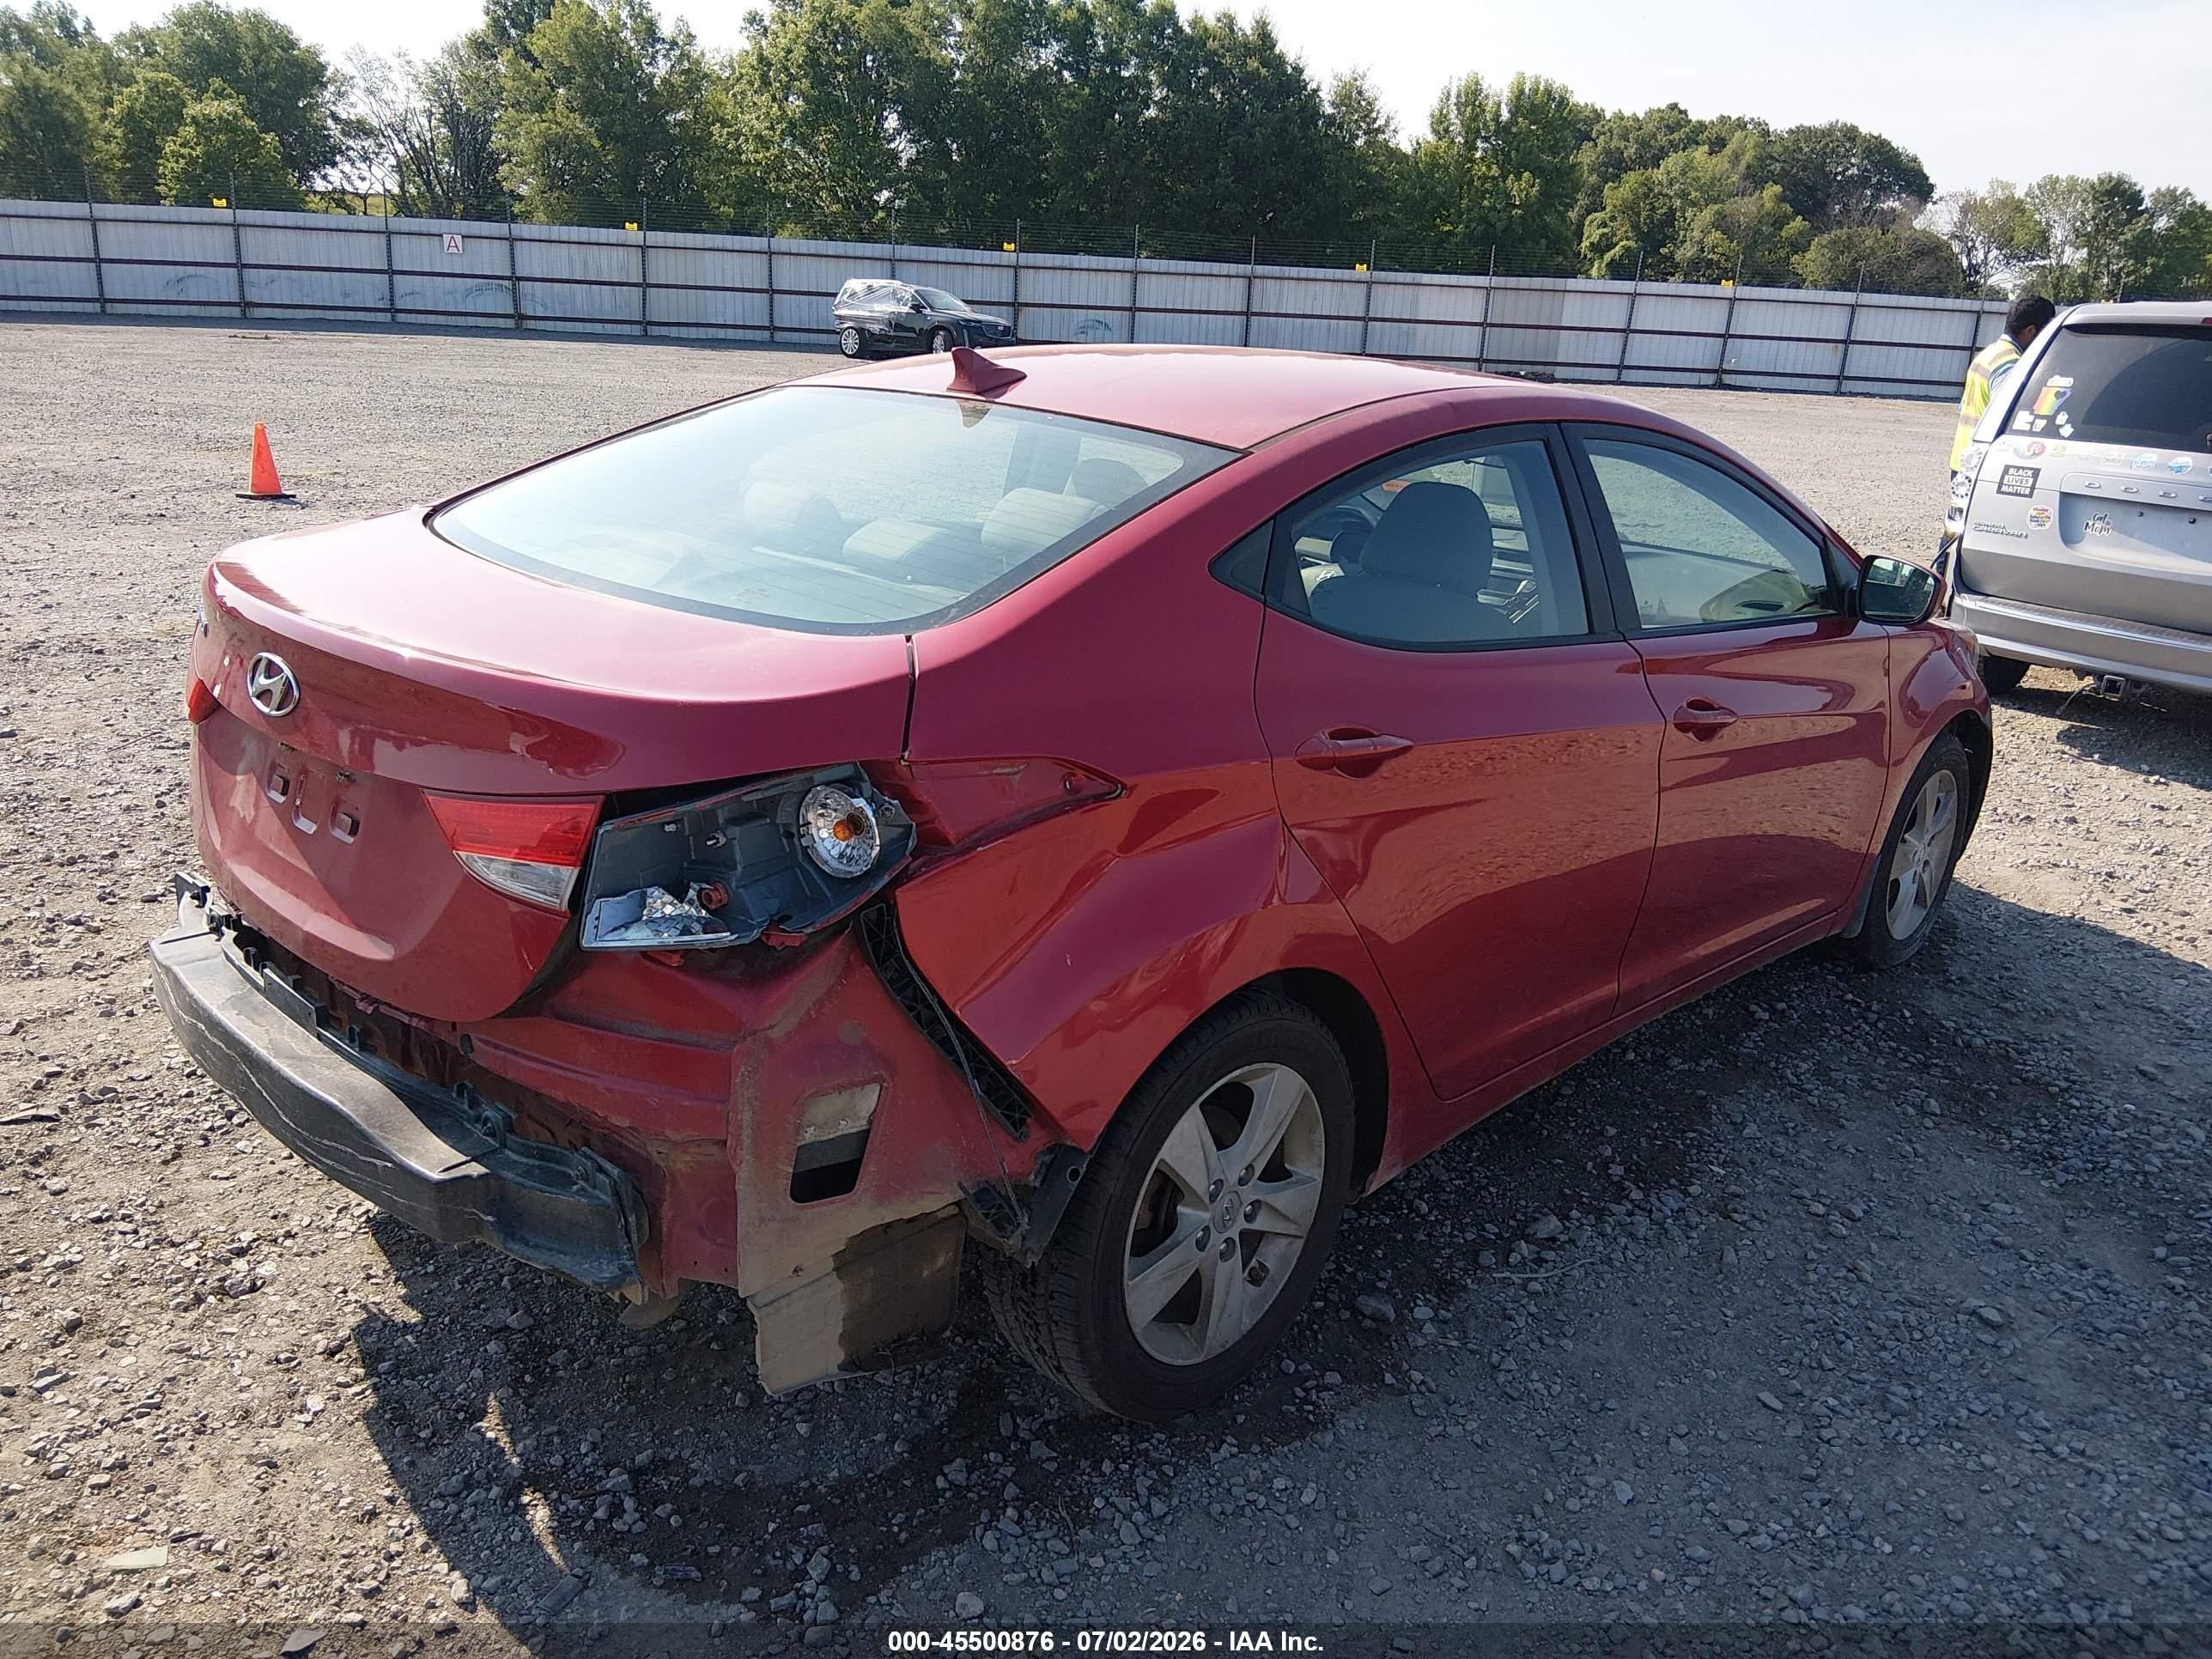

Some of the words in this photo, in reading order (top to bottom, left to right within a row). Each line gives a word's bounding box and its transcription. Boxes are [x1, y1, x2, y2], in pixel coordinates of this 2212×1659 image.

[447, 235, 460, 252] A
[2008, 467, 2034, 477] BLACK
[2006, 477, 2030, 485] LIVES
[2000, 484, 2032, 495] MATTER
[2084, 521, 2111, 535] Mom
